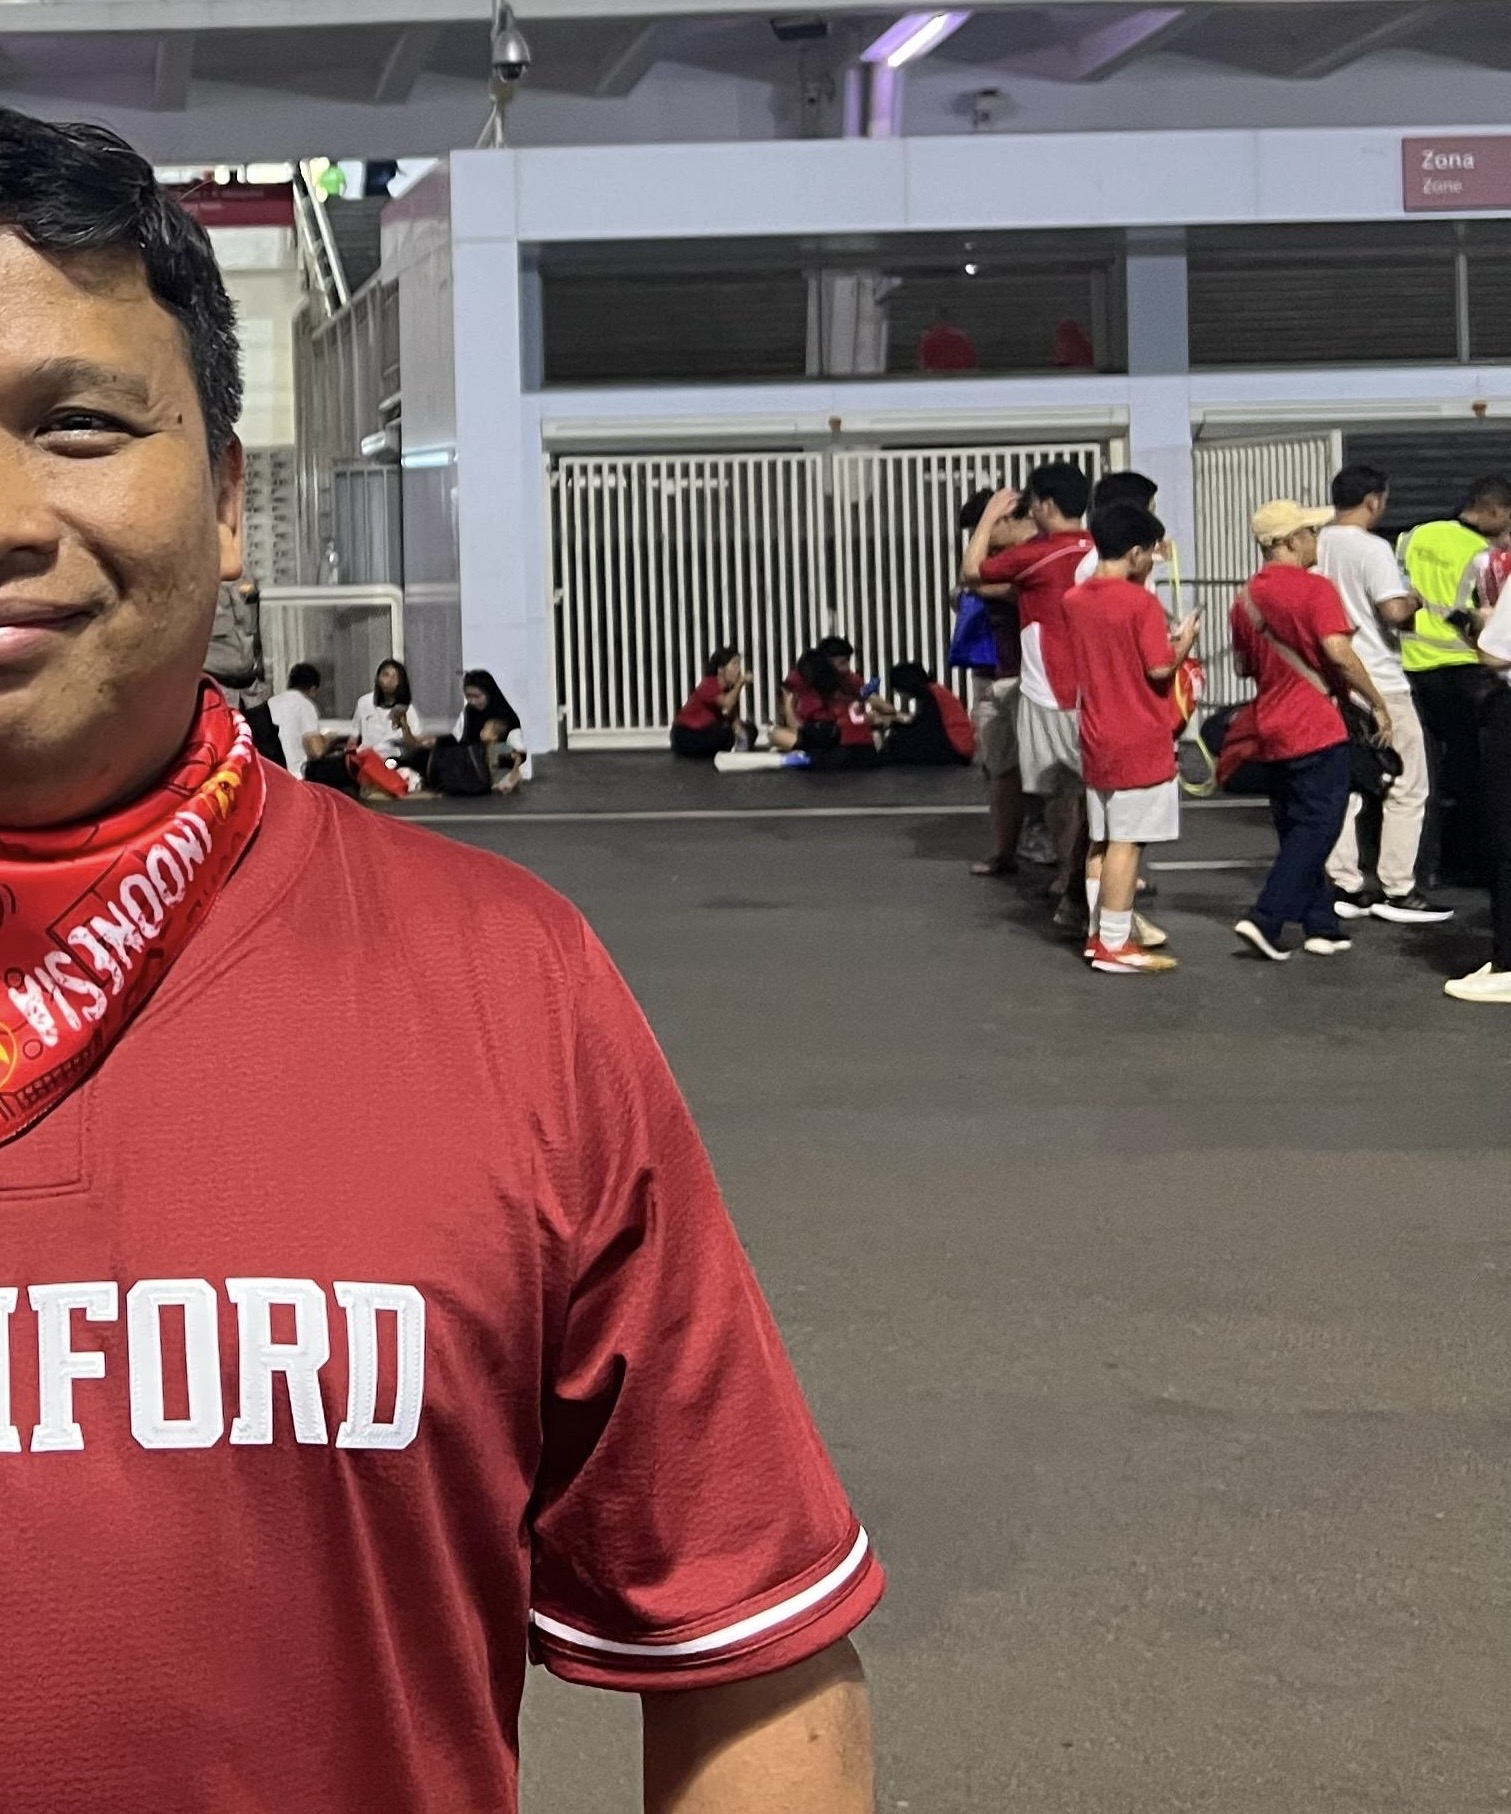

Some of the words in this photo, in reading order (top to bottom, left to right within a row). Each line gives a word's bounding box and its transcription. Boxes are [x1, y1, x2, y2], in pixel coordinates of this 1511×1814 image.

[1421, 149, 1475, 171] Zona
[1423, 176, 1464, 195] Zone
[7, 811, 213, 1047] INDONESIA
